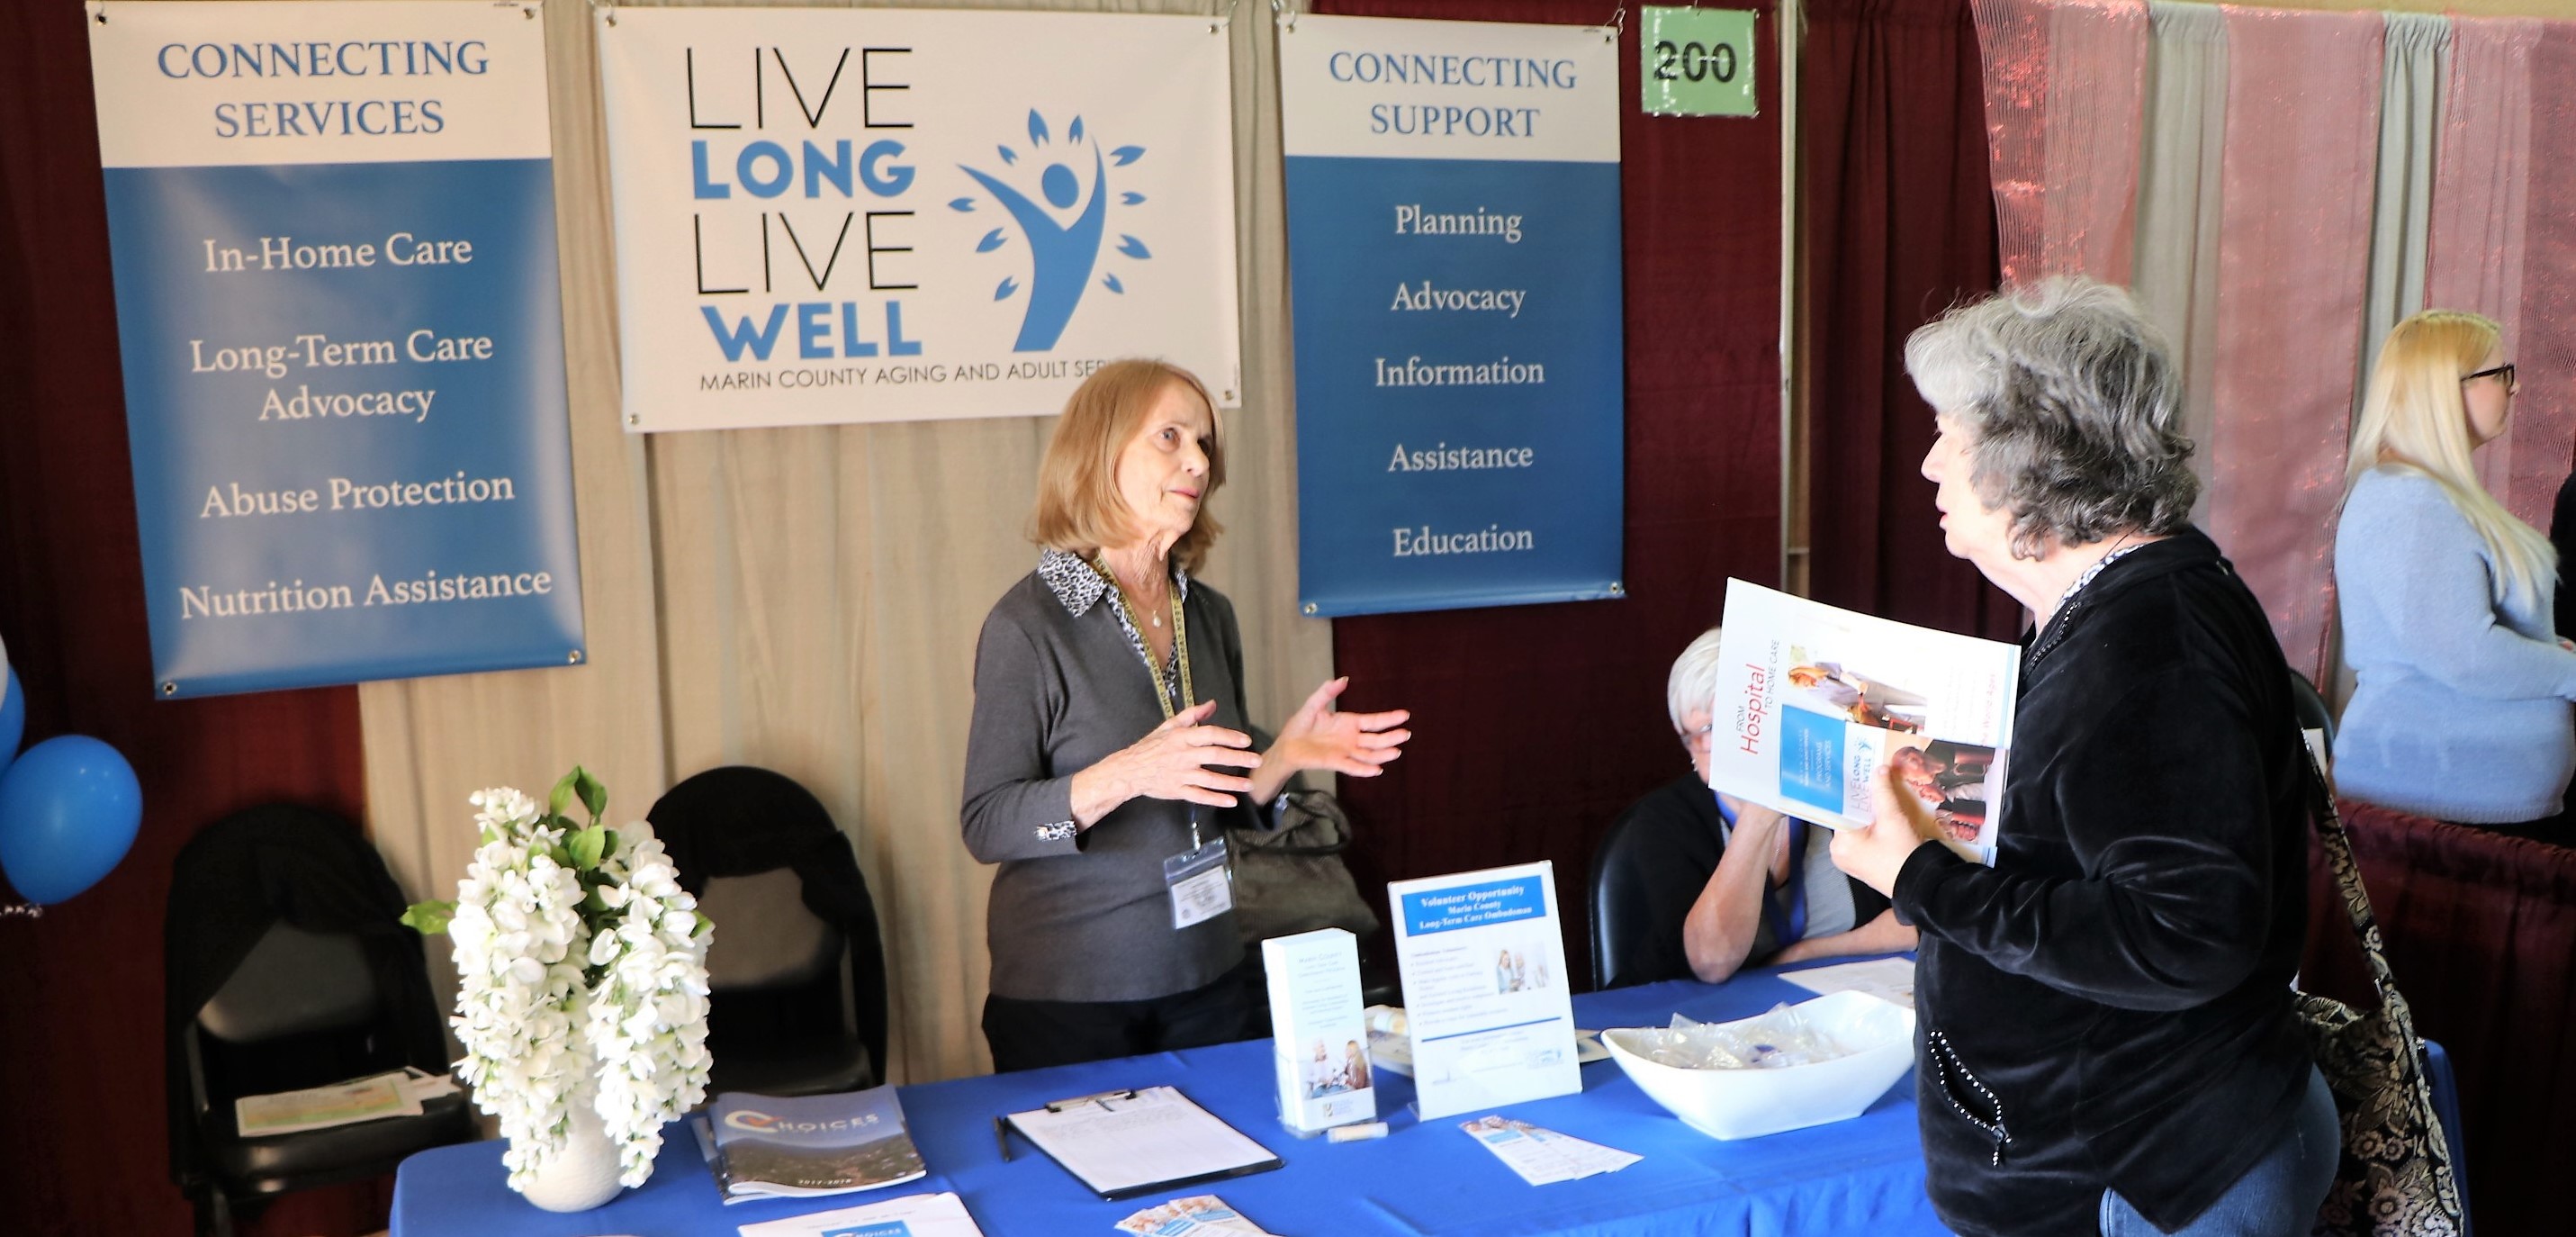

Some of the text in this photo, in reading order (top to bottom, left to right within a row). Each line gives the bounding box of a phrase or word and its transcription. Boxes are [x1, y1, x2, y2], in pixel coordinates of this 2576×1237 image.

[158, 41, 487, 78] CONNECTING
[1330, 52, 1575, 88] CONNECTING
[1653, 41, 1737, 84] 200
[688, 48, 914, 129] LIVE
[215, 101, 444, 137] SERVICES
[1372, 104, 1540, 137] SUPPORT
[692, 140, 914, 199] LONG
[1396, 204, 1522, 243] Planning
[204, 233, 472, 271] In-Home Care
[695, 212, 918, 294] LIVE
[1392, 281, 1526, 318] Advocacy
[700, 302, 922, 362] WELL
[190, 330, 492, 378] Long-Term Care
[1376, 357, 1544, 386] Information
[701, 372, 770, 390] MARIN
[779, 368, 867, 388] COUNTY
[876, 366, 946, 384] AGING
[955, 364, 999, 381] AND
[1007, 361, 1067, 379] ADULT
[259, 385, 436, 422] Advocacy
[1389, 443, 1533, 472] Assistance
[201, 471, 514, 518] Abuse Protection
[1393, 526, 1533, 556] Education
[180, 571, 550, 618] Nutrition Assistance
[1764, 639, 1780, 709] TO HOME CARE
[1735, 705, 1745, 732] FROM
[1740, 663, 1769, 755] Hospital
[1850, 755, 1860, 808] LIVE LONG
[1860, 758, 1872, 812] LIVE WELL
[1421, 885, 1525, 907] Volunteer Opportunity
[724, 1109, 879, 1133] CHOICES
